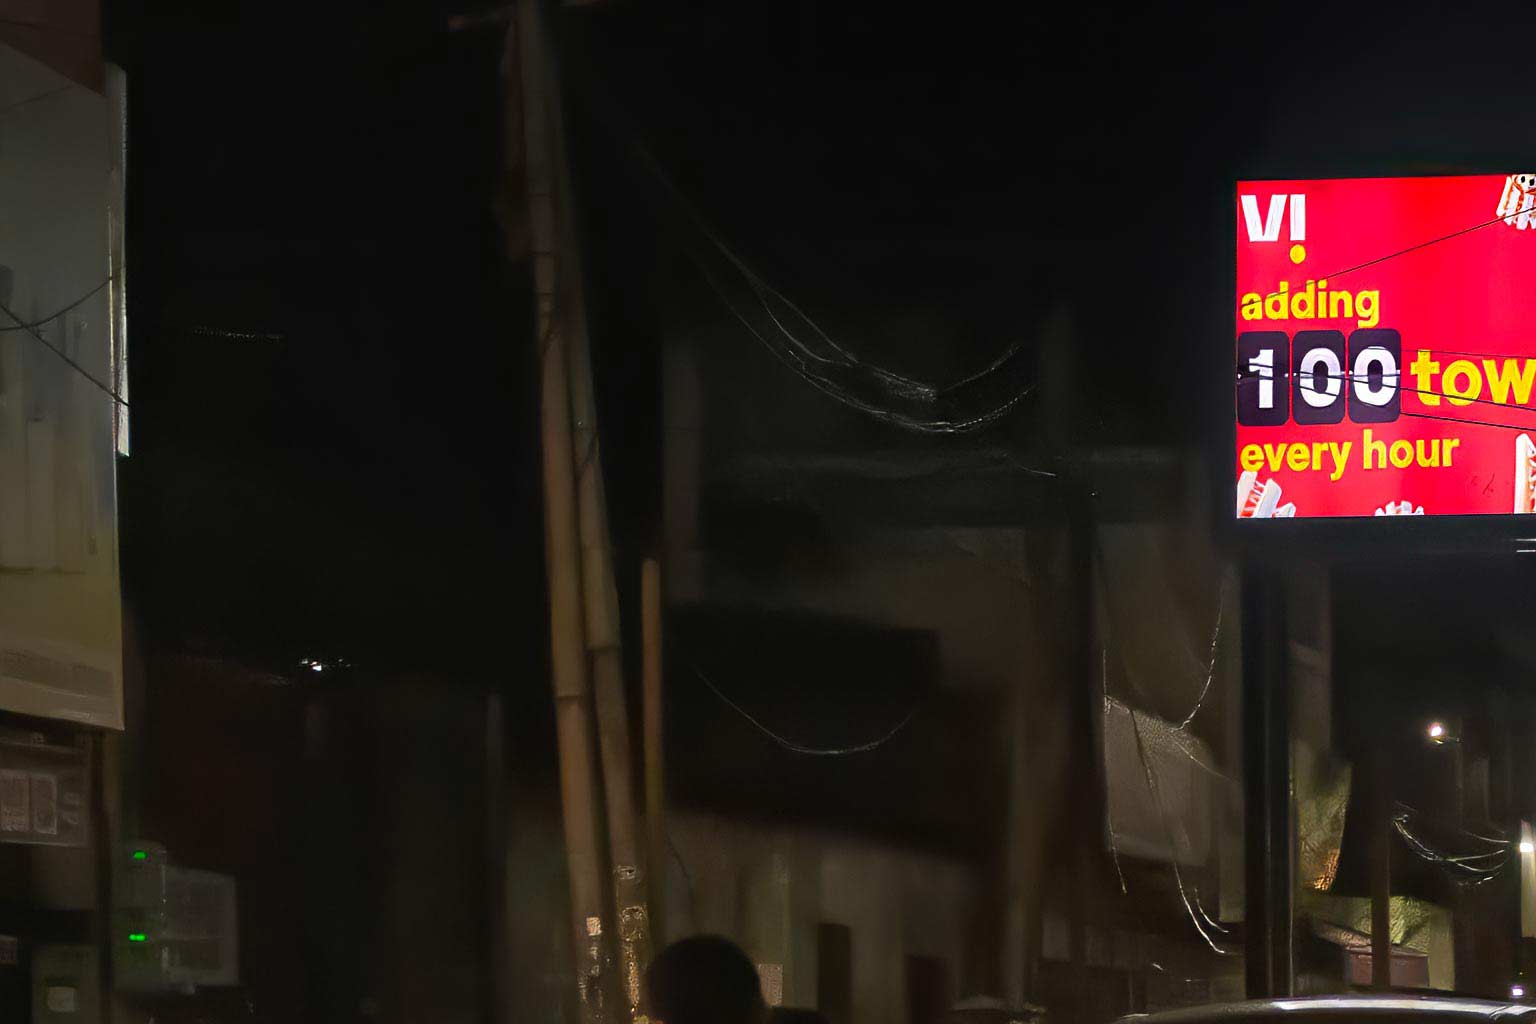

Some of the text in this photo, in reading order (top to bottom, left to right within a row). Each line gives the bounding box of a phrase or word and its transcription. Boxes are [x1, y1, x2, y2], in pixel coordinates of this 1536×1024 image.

[1241, 279, 1380, 329] adding
[1246, 345, 1399, 409] 100
[1239, 428, 1460, 481] every hour
